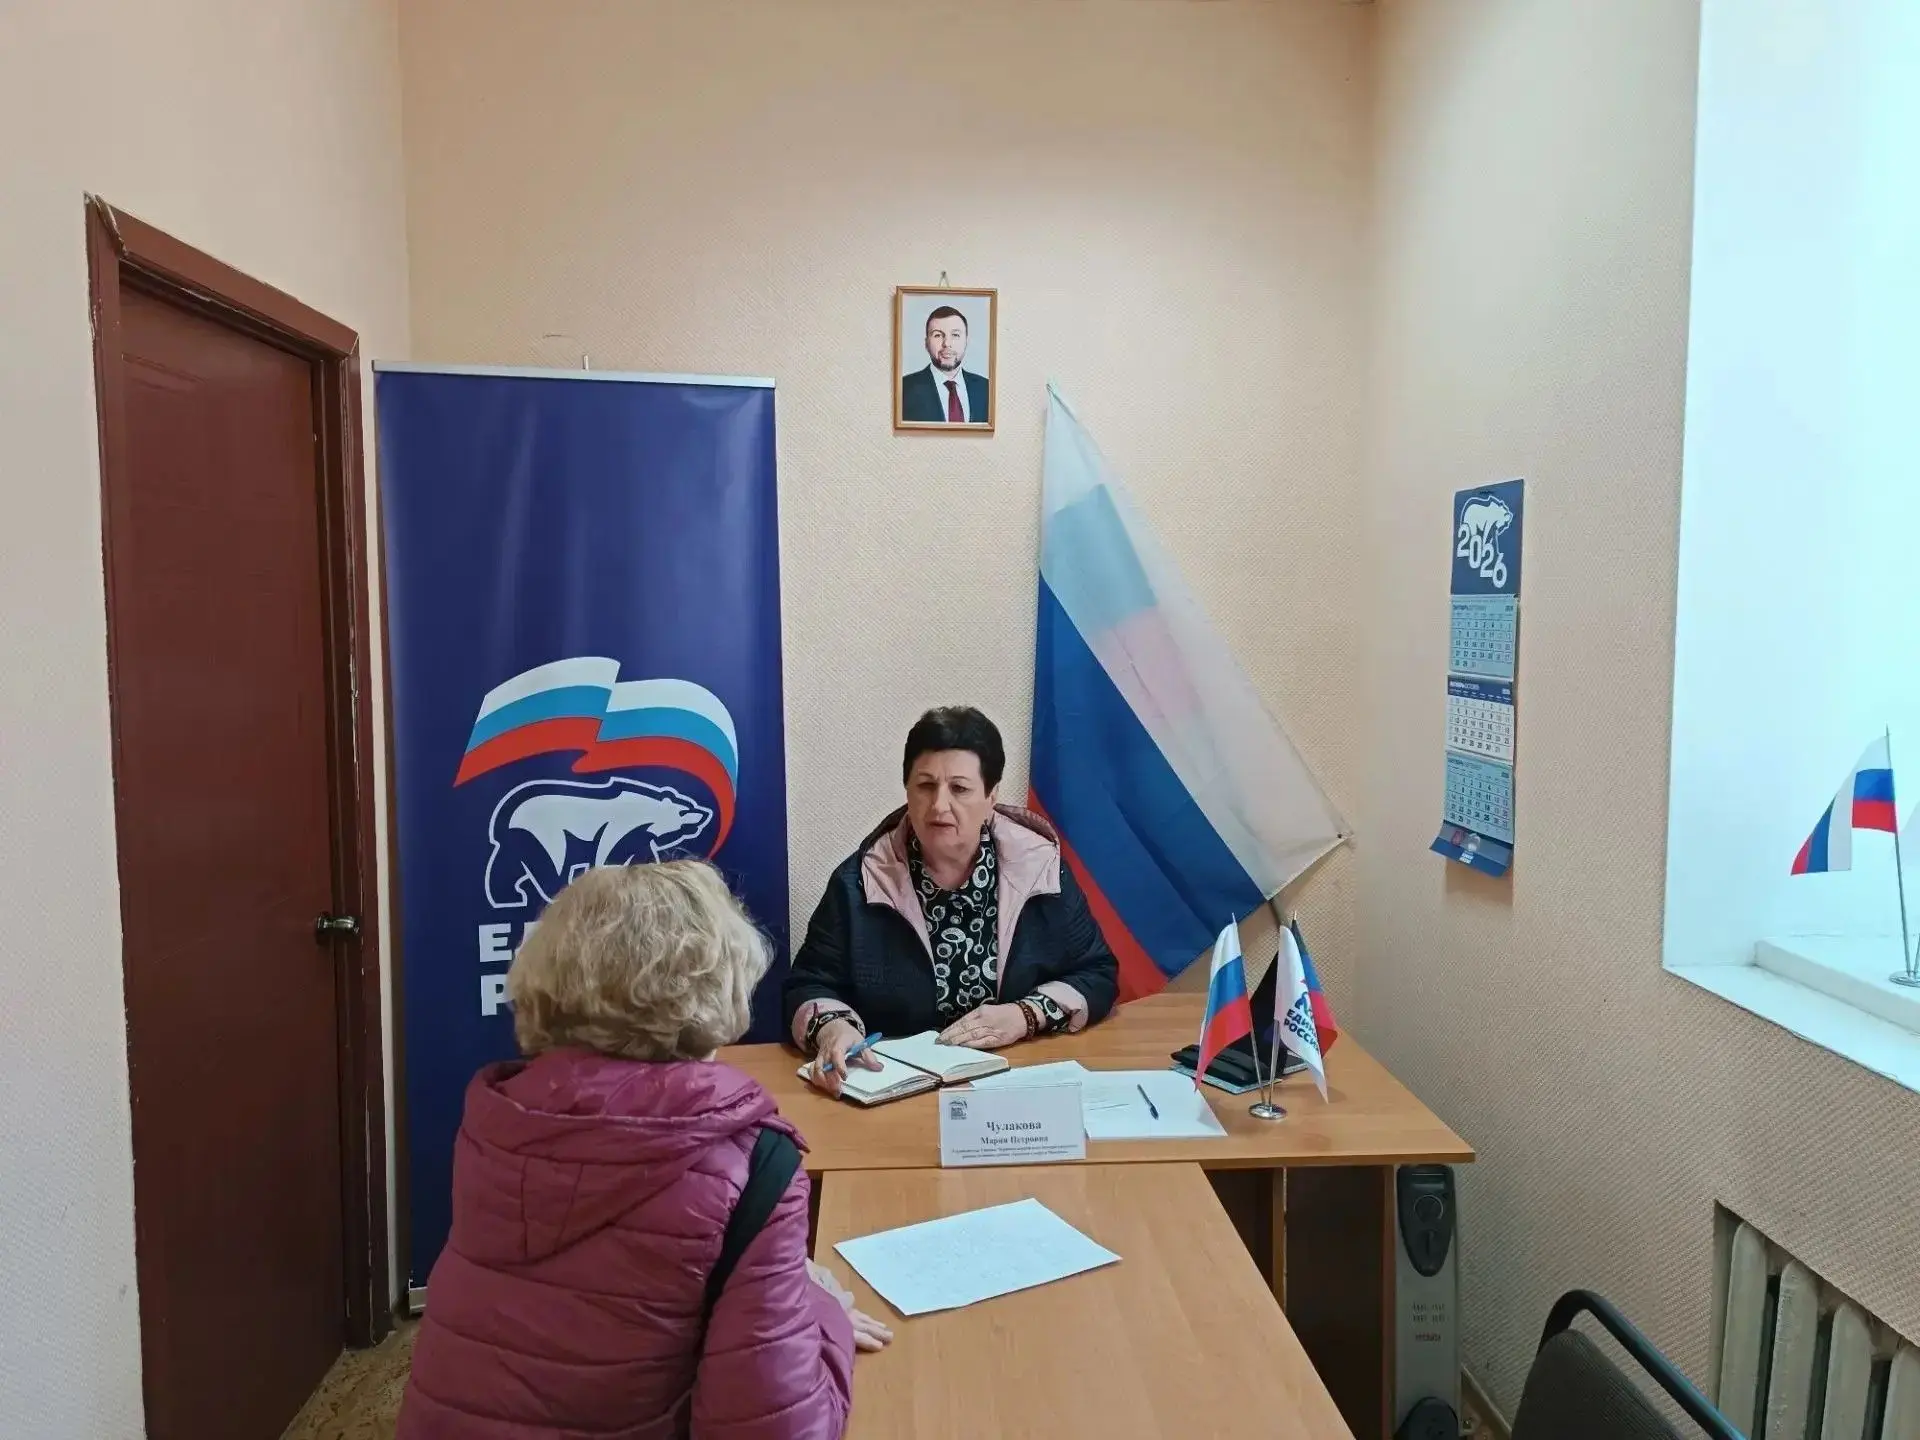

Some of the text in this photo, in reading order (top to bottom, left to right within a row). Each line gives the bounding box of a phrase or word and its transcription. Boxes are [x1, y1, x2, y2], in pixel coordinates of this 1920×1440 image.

[1457, 522, 1507, 588] 2026
[1284, 1018, 1318, 1051] РОССИ
[986, 1121, 1042, 1134] Чулакова
[980, 1135, 1049, 1146] Мария Петровна
